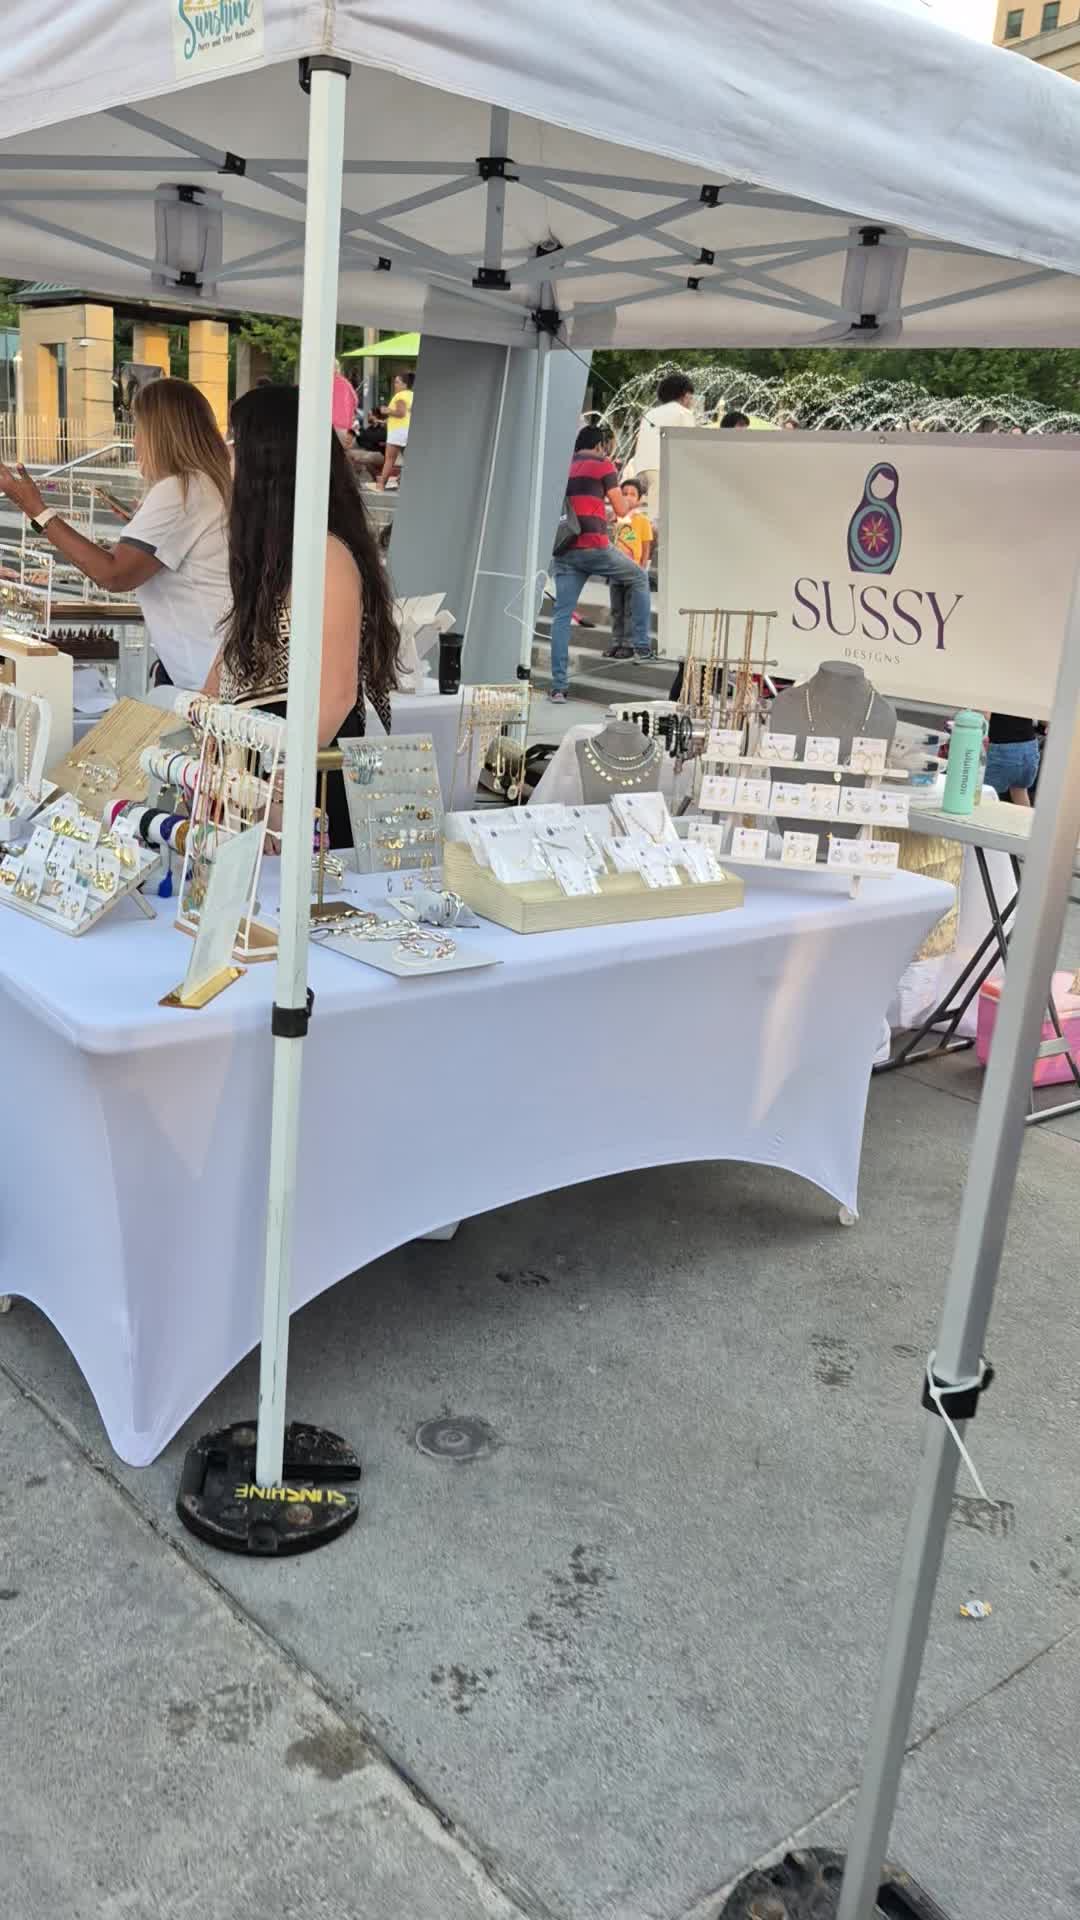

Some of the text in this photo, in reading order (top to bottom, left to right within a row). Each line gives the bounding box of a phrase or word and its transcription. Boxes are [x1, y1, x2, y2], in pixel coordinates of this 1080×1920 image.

[178, 0, 254, 59] Sunshine
[792, 577, 964, 650] SUSSY
[844, 647, 901, 665] DESIGNS
[234, 1482, 347, 1505] SUNSHINE
